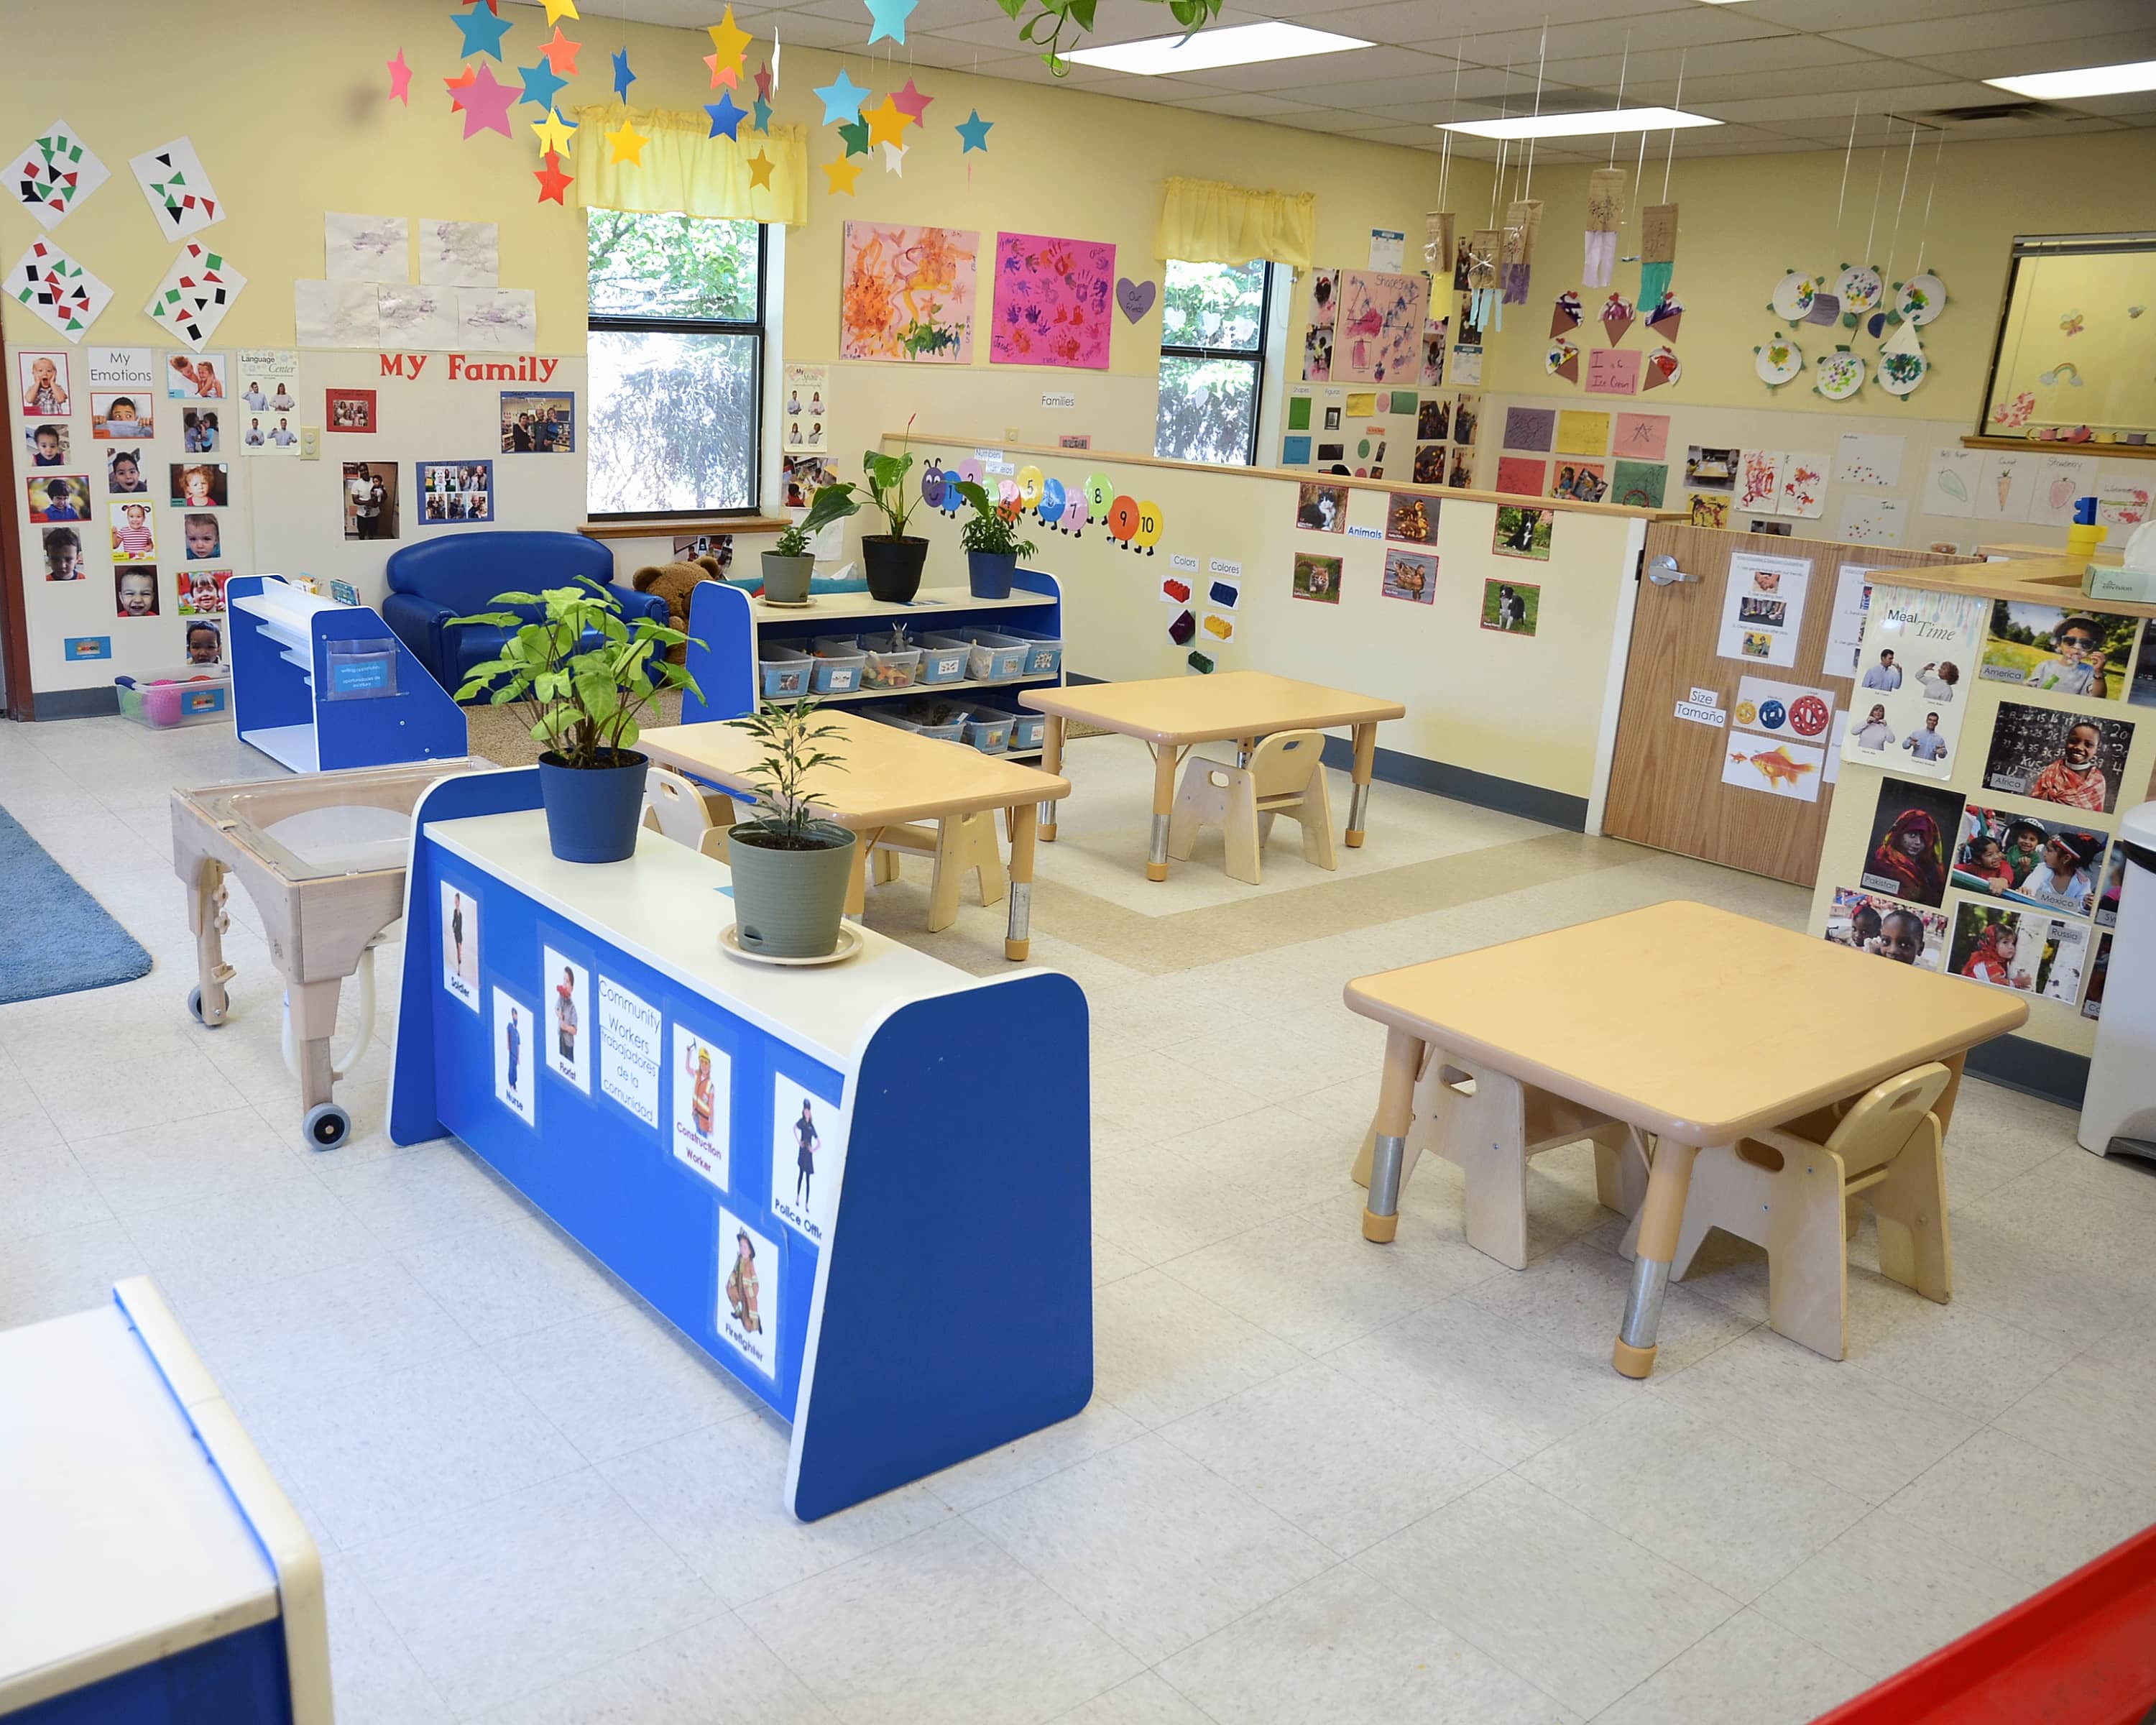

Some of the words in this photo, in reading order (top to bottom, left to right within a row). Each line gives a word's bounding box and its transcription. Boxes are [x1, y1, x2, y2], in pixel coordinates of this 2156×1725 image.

[1128, 290, 1142, 302] Our
[110, 352, 131, 366] My
[241, 355, 275, 364] Language
[90, 369, 152, 382] Emotions
[268, 362, 295, 374] Center
[379, 353, 428, 381] My
[448, 353, 560, 383] Family
[1041, 395, 1074, 407] Families
[975, 448, 1001, 459] Numbers
[948, 484, 952, 500] 1
[1026, 479, 1034, 495] 5
[1094, 487, 1102, 504] 8
[1047, 493, 1055, 507] 6
[1069, 503, 1077, 519] 7
[1120, 510, 1128, 527] 9
[1141, 516, 1154, 533] 10
[1348, 526, 1382, 539] Animals
[1174, 555, 1196, 568] Colors
[1211, 561, 1240, 574] Colores
[1887, 609, 1918, 624] Meal
[1915, 620, 1956, 641] Time
[1984, 667, 2022, 680] America
[1690, 691, 1713, 705] Size
[1677, 704, 1724, 724] Tamaño
[2109, 723, 2128, 740] 20
[1994, 776, 2021, 788] Africa
[1864, 875, 1897, 891] Pakistan
[2040, 894, 2074, 908] Mexico
[2051, 929, 2078, 940] Russia
[451, 976, 470, 998] Soldier
[598, 979, 661, 1034] Community
[608, 1013, 650, 1054] Workers
[600, 1029, 656, 1077] trabajadores
[559, 1061, 576, 1080] Florist
[617, 1062, 630, 1082] de
[630, 1071, 639, 1089] la
[506, 1088, 523, 1111] Nurse
[603, 1078, 653, 1122] comunidad
[676, 1121, 722, 1160] Construction
[685, 1146, 712, 1173] Worker
[775, 1197, 801, 1226] Police
[725, 1322, 763, 1362] Firefighter
